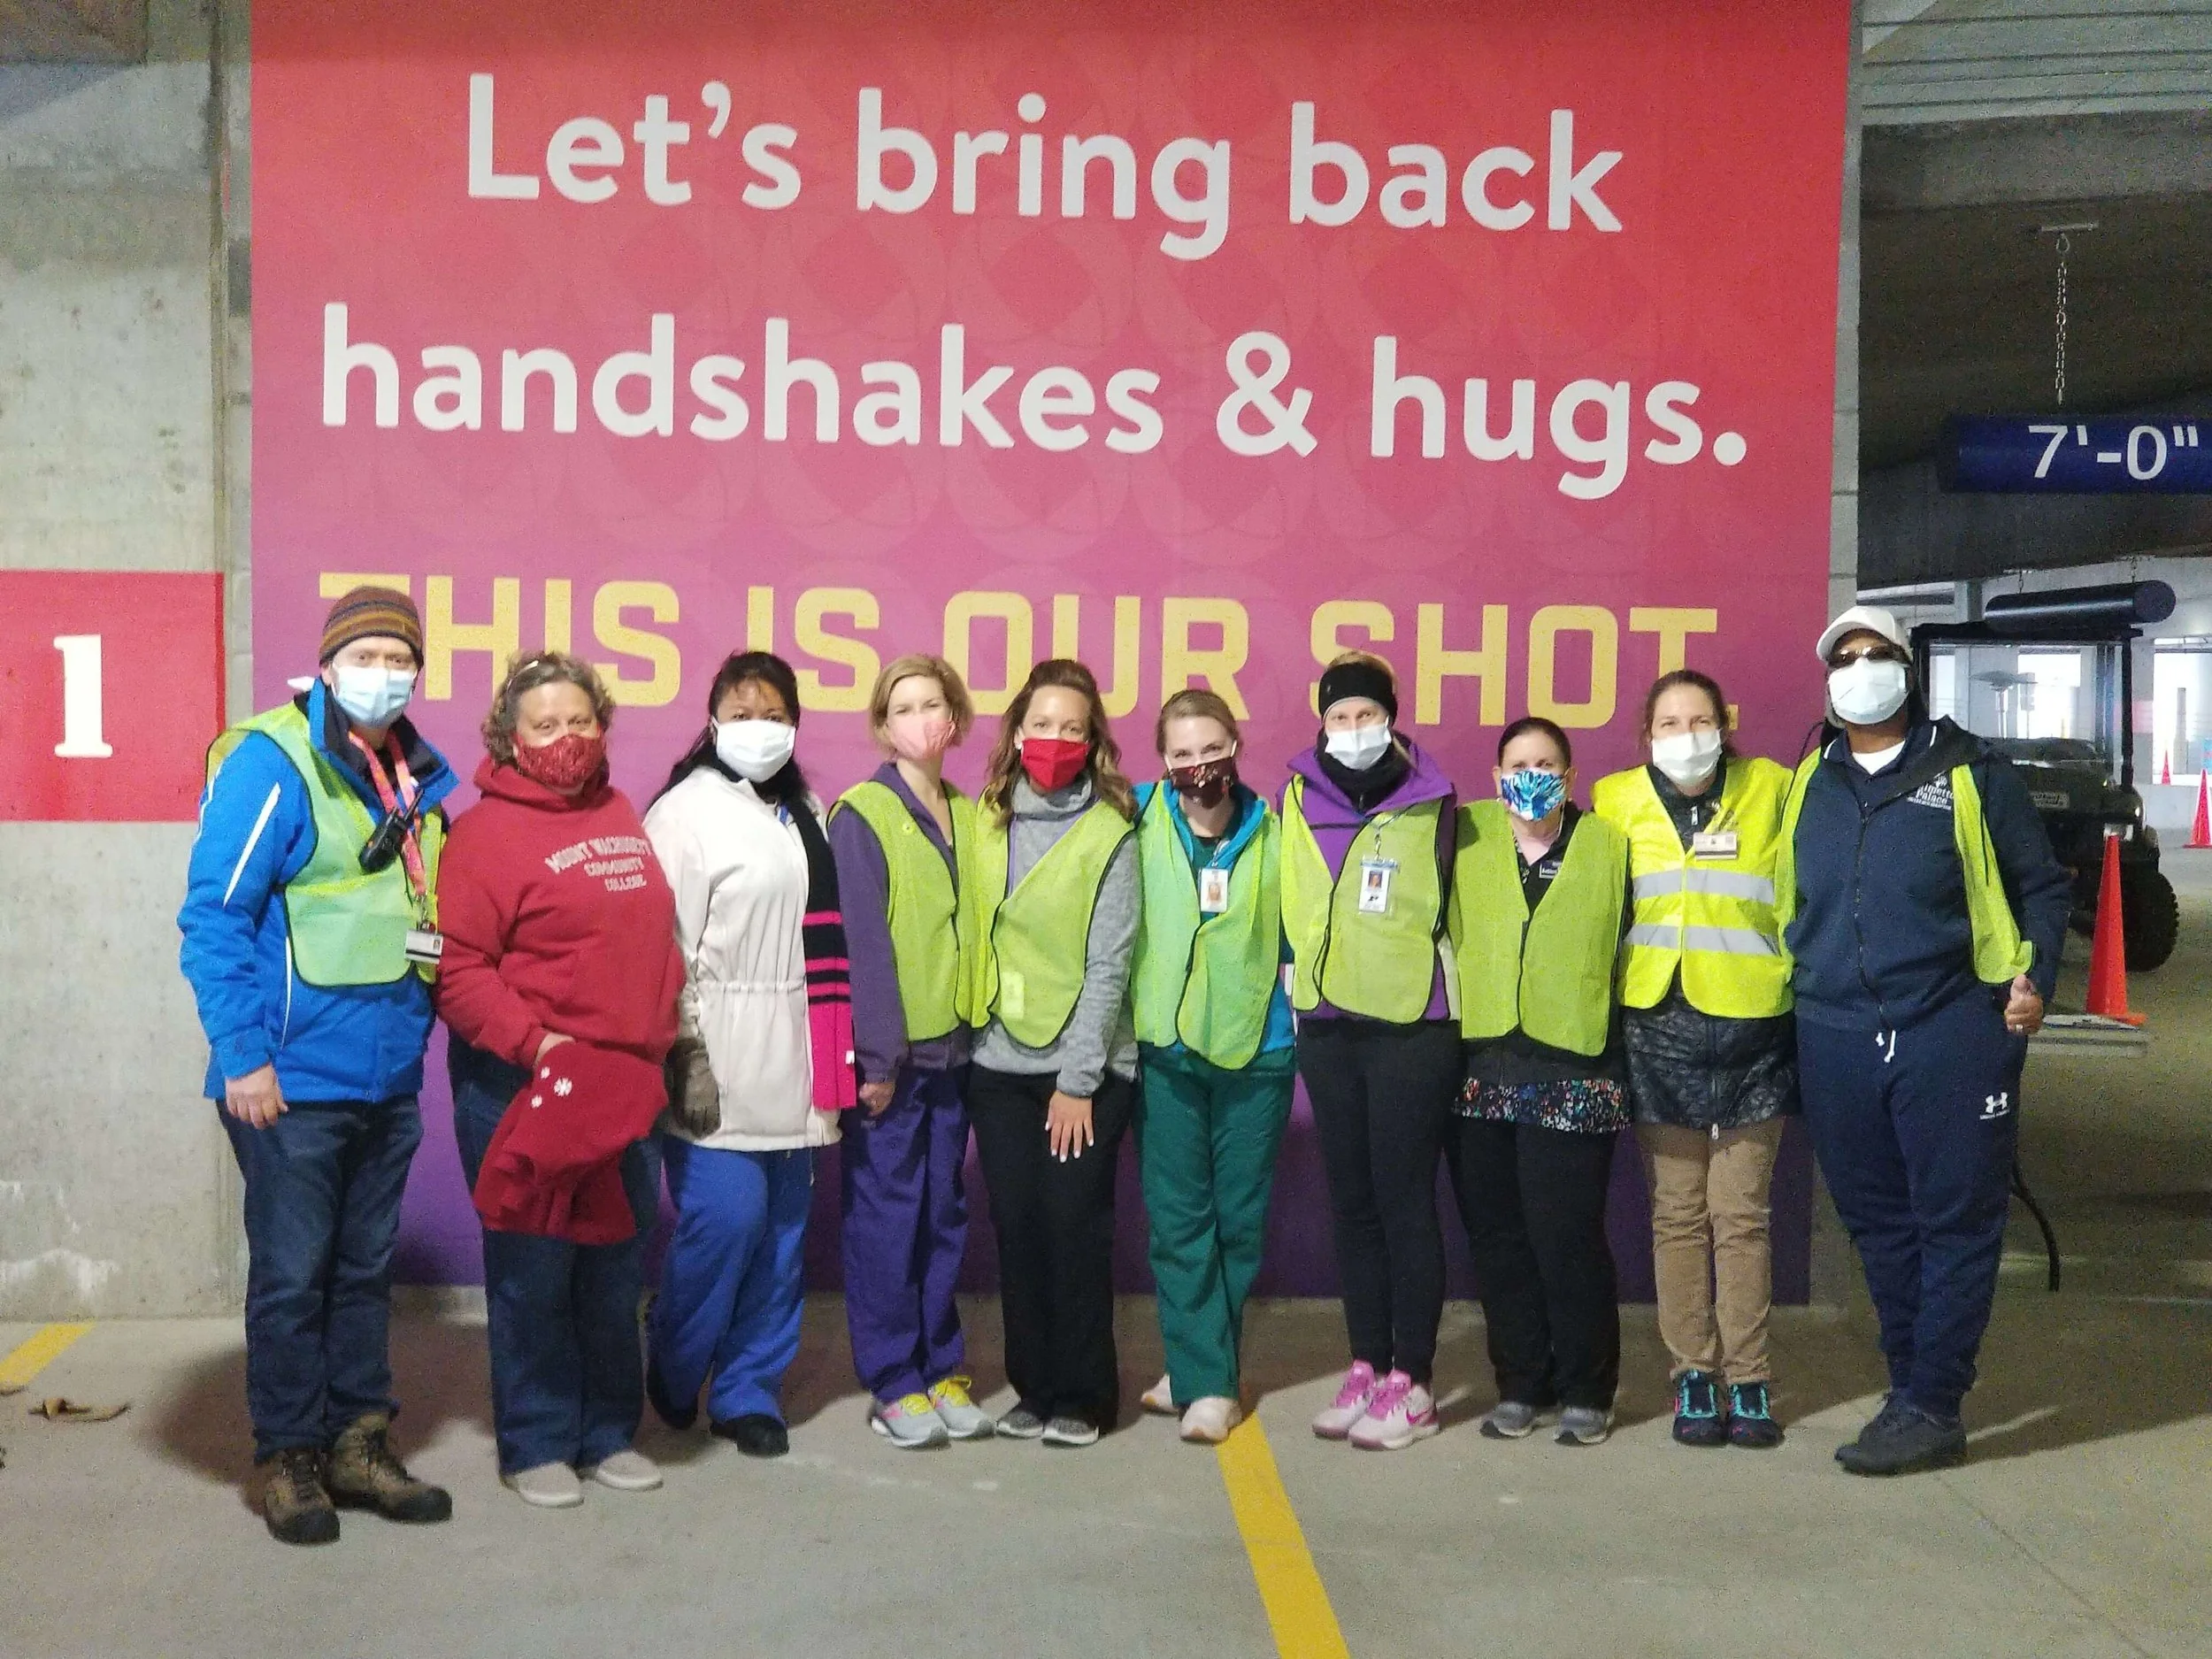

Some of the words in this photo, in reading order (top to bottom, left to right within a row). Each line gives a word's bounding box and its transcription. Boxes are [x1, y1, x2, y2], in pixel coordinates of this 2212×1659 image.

[467, 73, 802, 210] Let’s
[857, 88, 1231, 260] bring
[1290, 102, 1624, 233] back
[322, 302, 1164, 454] handshakes
[1216, 331, 1318, 457] &
[1371, 335, 1747, 500] hugs.
[53, 633, 113, 758] 1
[746, 587, 881, 711] IS
[941, 591, 1249, 721] OUR
